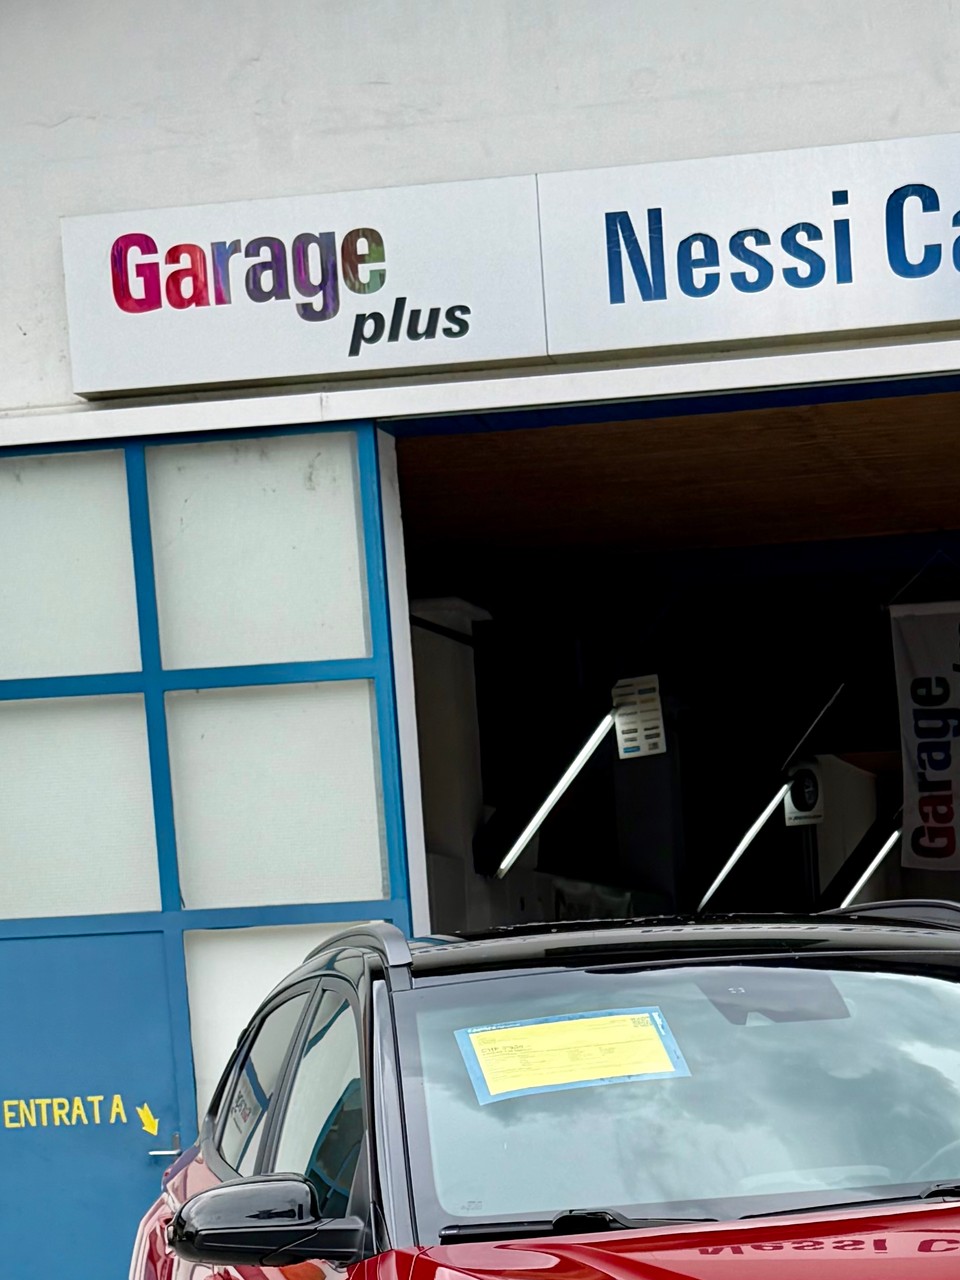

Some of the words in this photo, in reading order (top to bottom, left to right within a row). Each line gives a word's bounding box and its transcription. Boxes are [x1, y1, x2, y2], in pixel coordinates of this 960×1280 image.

[110, 227, 387, 322] Garage
[604, 190, 854, 305] Nessi
[348, 297, 471, 357] plus
[3, 1094, 127, 1128] ENTRATA
